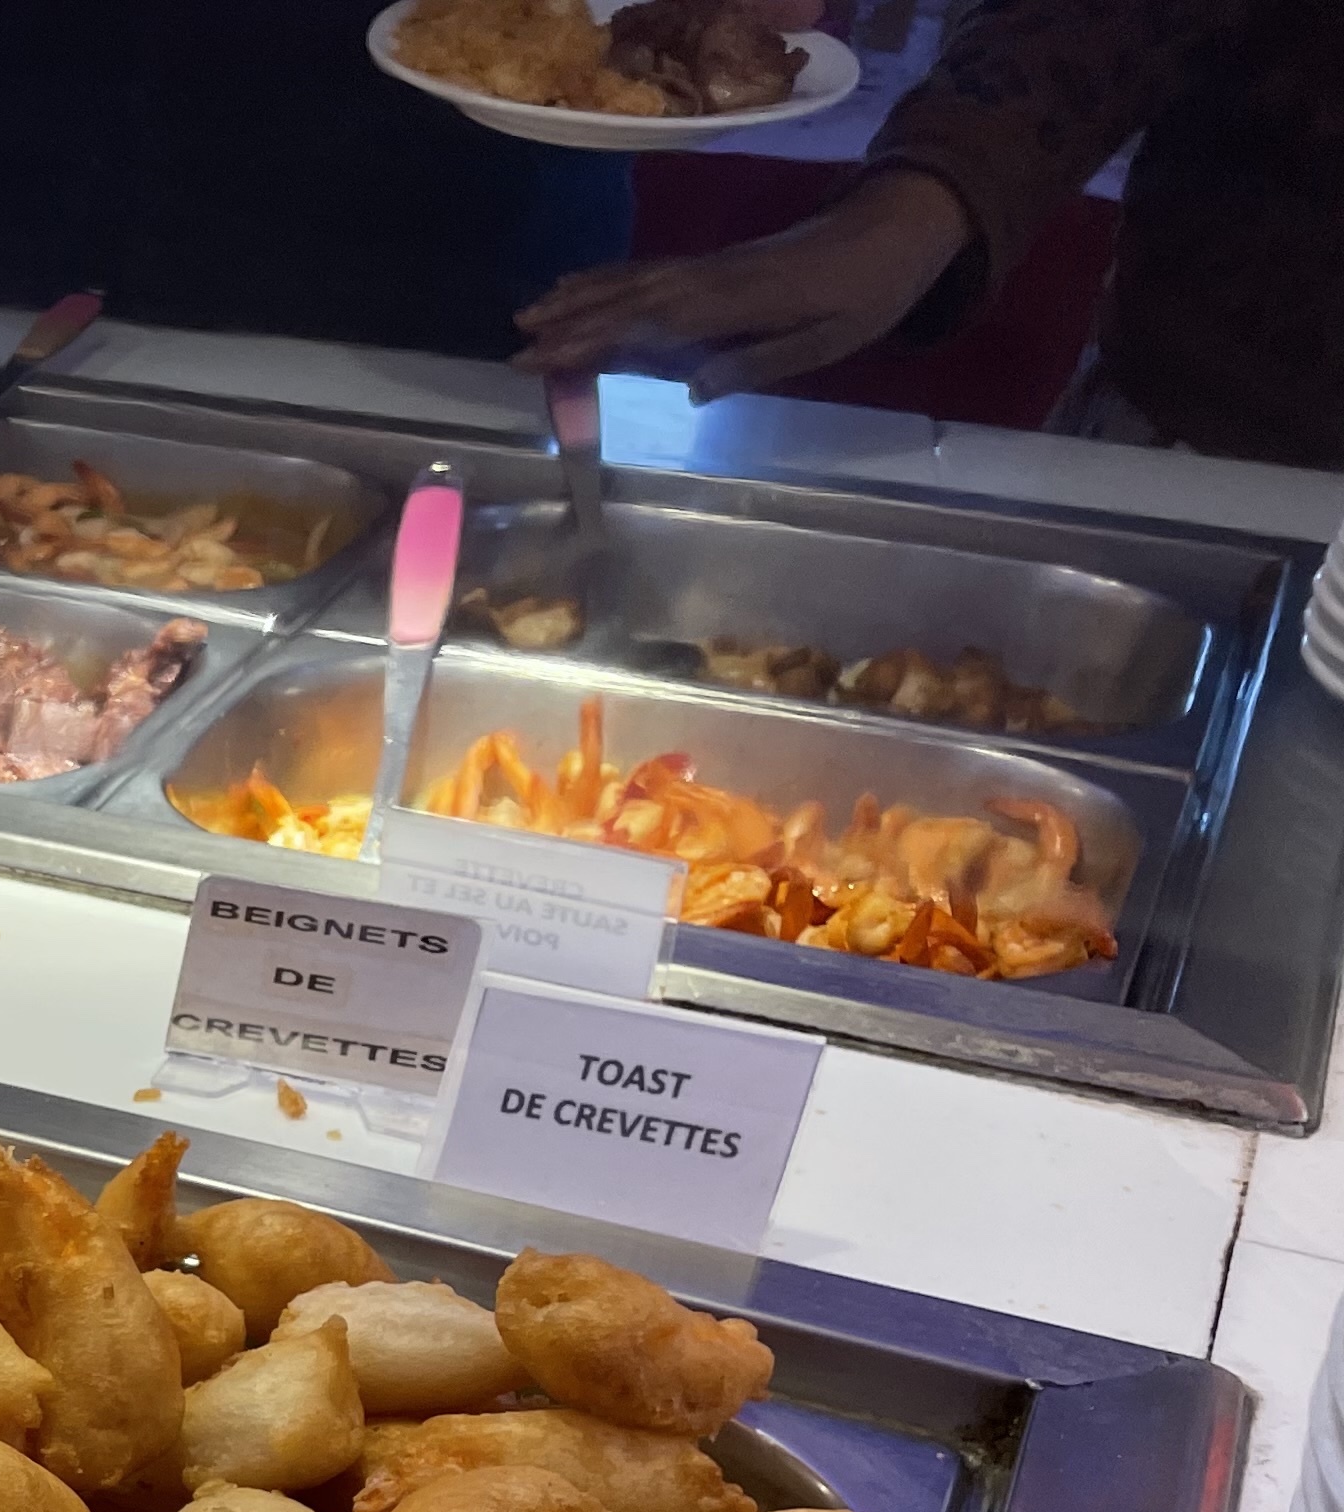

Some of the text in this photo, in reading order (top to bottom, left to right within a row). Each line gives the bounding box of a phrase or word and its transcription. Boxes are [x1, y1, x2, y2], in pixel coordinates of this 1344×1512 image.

[210, 900, 450, 954] BEIGNETS
[272, 966, 336, 995] DE
[170, 1013, 449, 1073] CREVETTES
[578, 1052, 692, 1100] TOAST
[499, 1086, 743, 1160] DE CREVETTES
